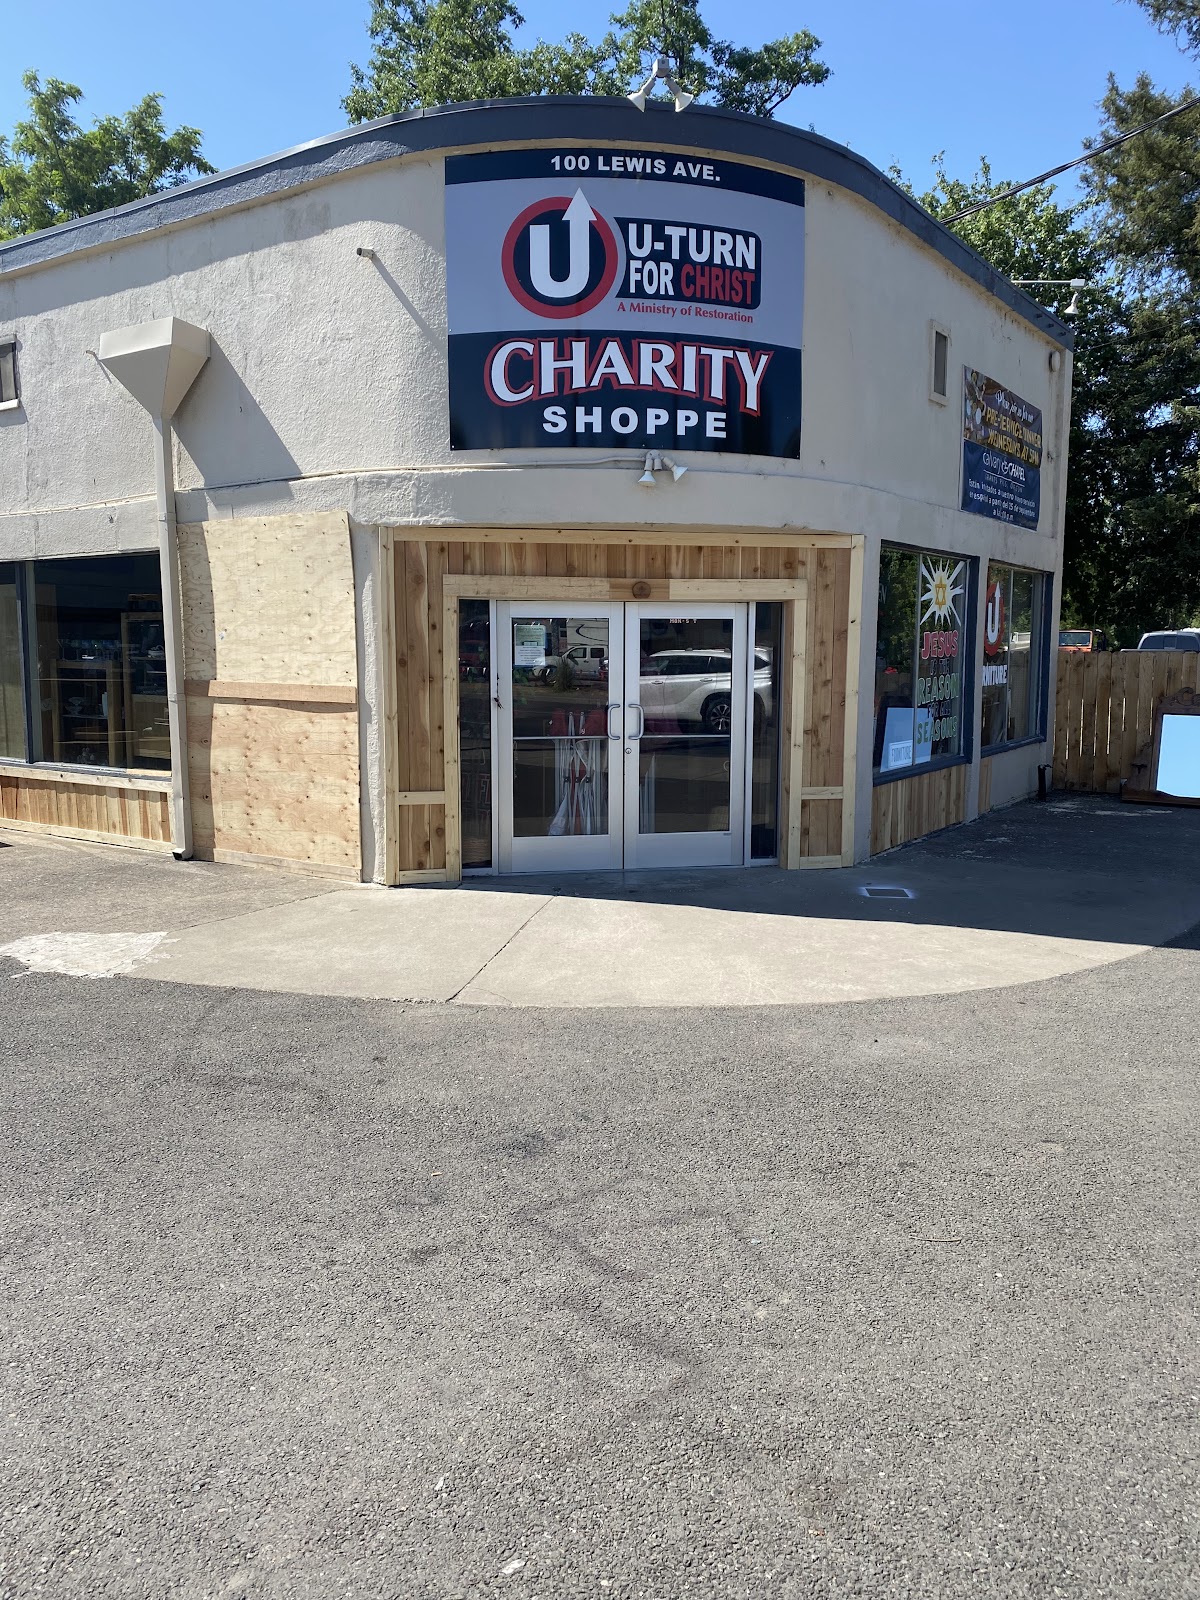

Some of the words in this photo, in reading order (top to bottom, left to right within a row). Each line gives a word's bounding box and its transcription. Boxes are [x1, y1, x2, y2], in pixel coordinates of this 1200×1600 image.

[550, 155, 590, 171] 100
[598, 156, 666, 174] LEWIS
[672, 162, 721, 182] AVE.
[628, 222, 756, 270] U-TURN
[629, 259, 675, 296] FOR
[680, 263, 756, 305] CHRIST
[617, 302, 626, 312] A
[629, 302, 678, 318] Ministry
[680, 306, 692, 316] of
[694, 306, 754, 323] Restoration
[483, 337, 775, 417] CHARITY
[542, 405, 727, 439] SHOPPE
[1021, 444, 1030, 462] AT
[921, 630, 959, 659] JESUS
[917, 673, 960, 706] REASON
[917, 716, 958, 745] SEASONS
